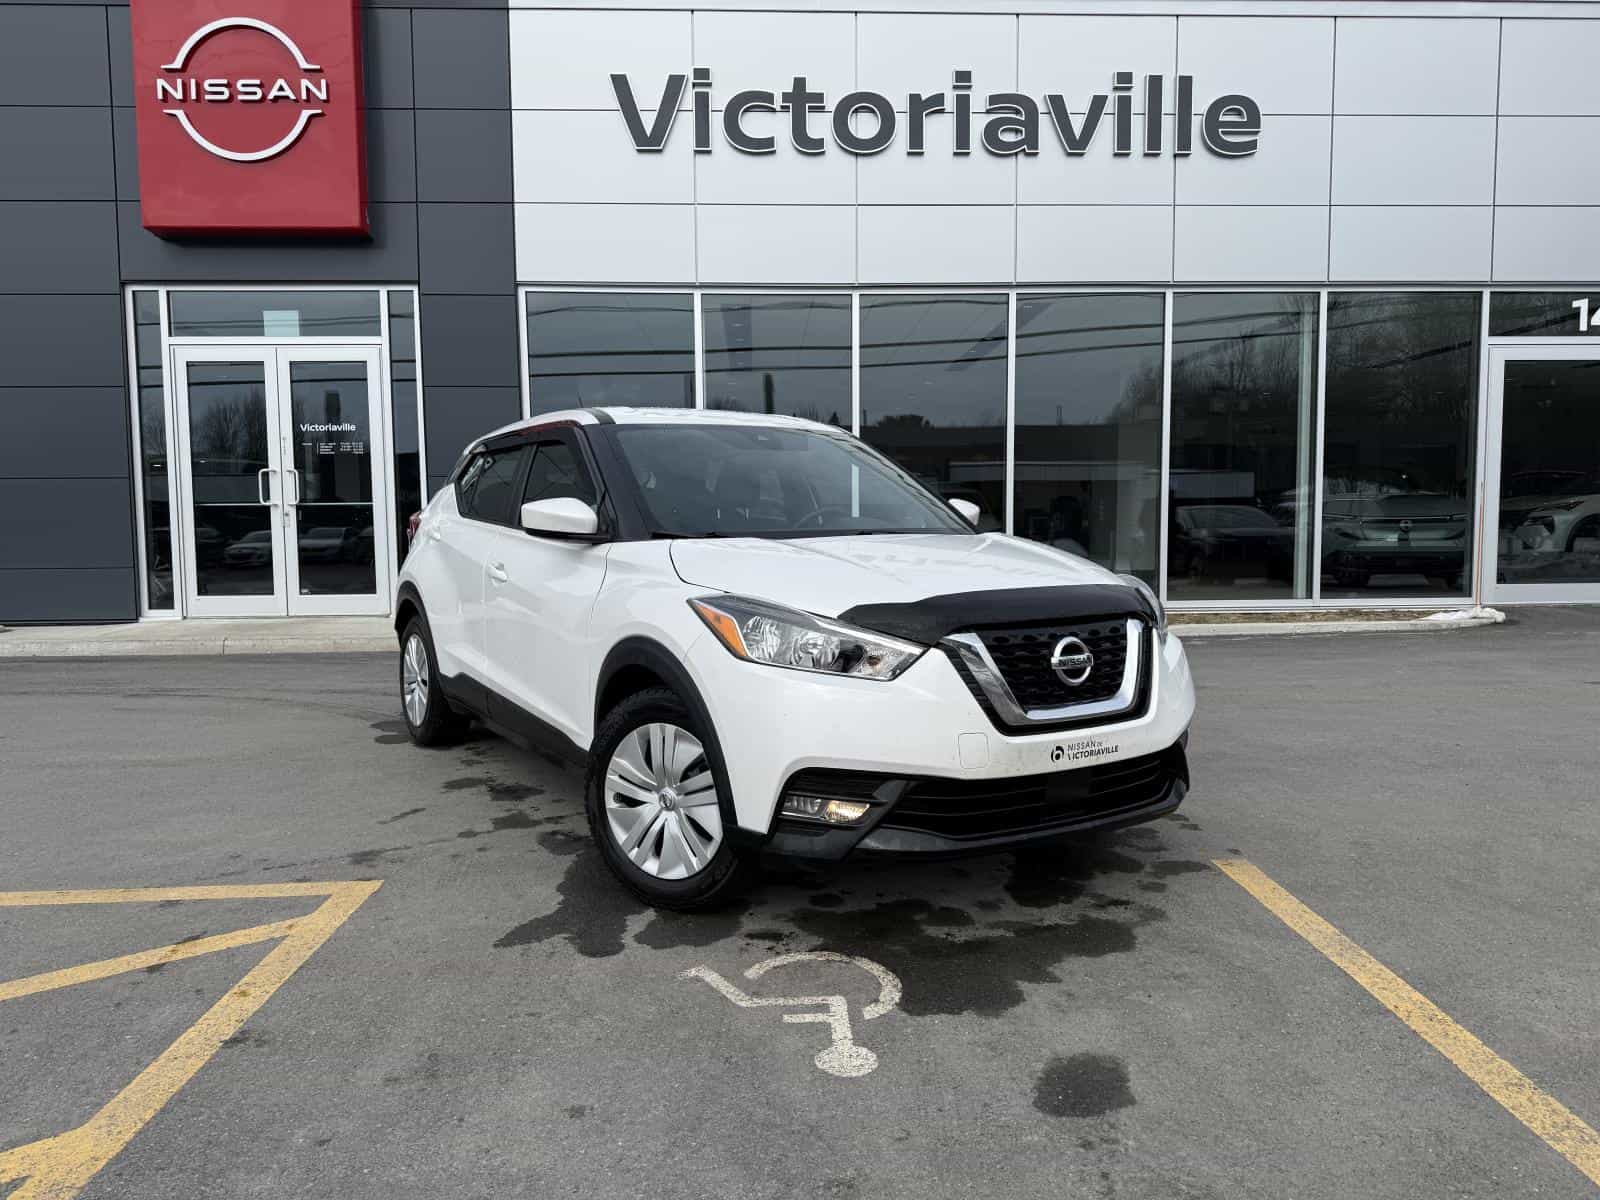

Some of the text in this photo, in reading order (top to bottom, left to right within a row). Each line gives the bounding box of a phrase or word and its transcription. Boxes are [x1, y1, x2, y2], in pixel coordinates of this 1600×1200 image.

[156, 78, 328, 102] NISSAN
[609, 67, 1262, 158] Victoriaville
[300, 423, 356, 432] Victoriaville
[1067, 740, 1096, 751] NISSAN
[1067, 744, 1119, 761] VICTORIAVILLE
